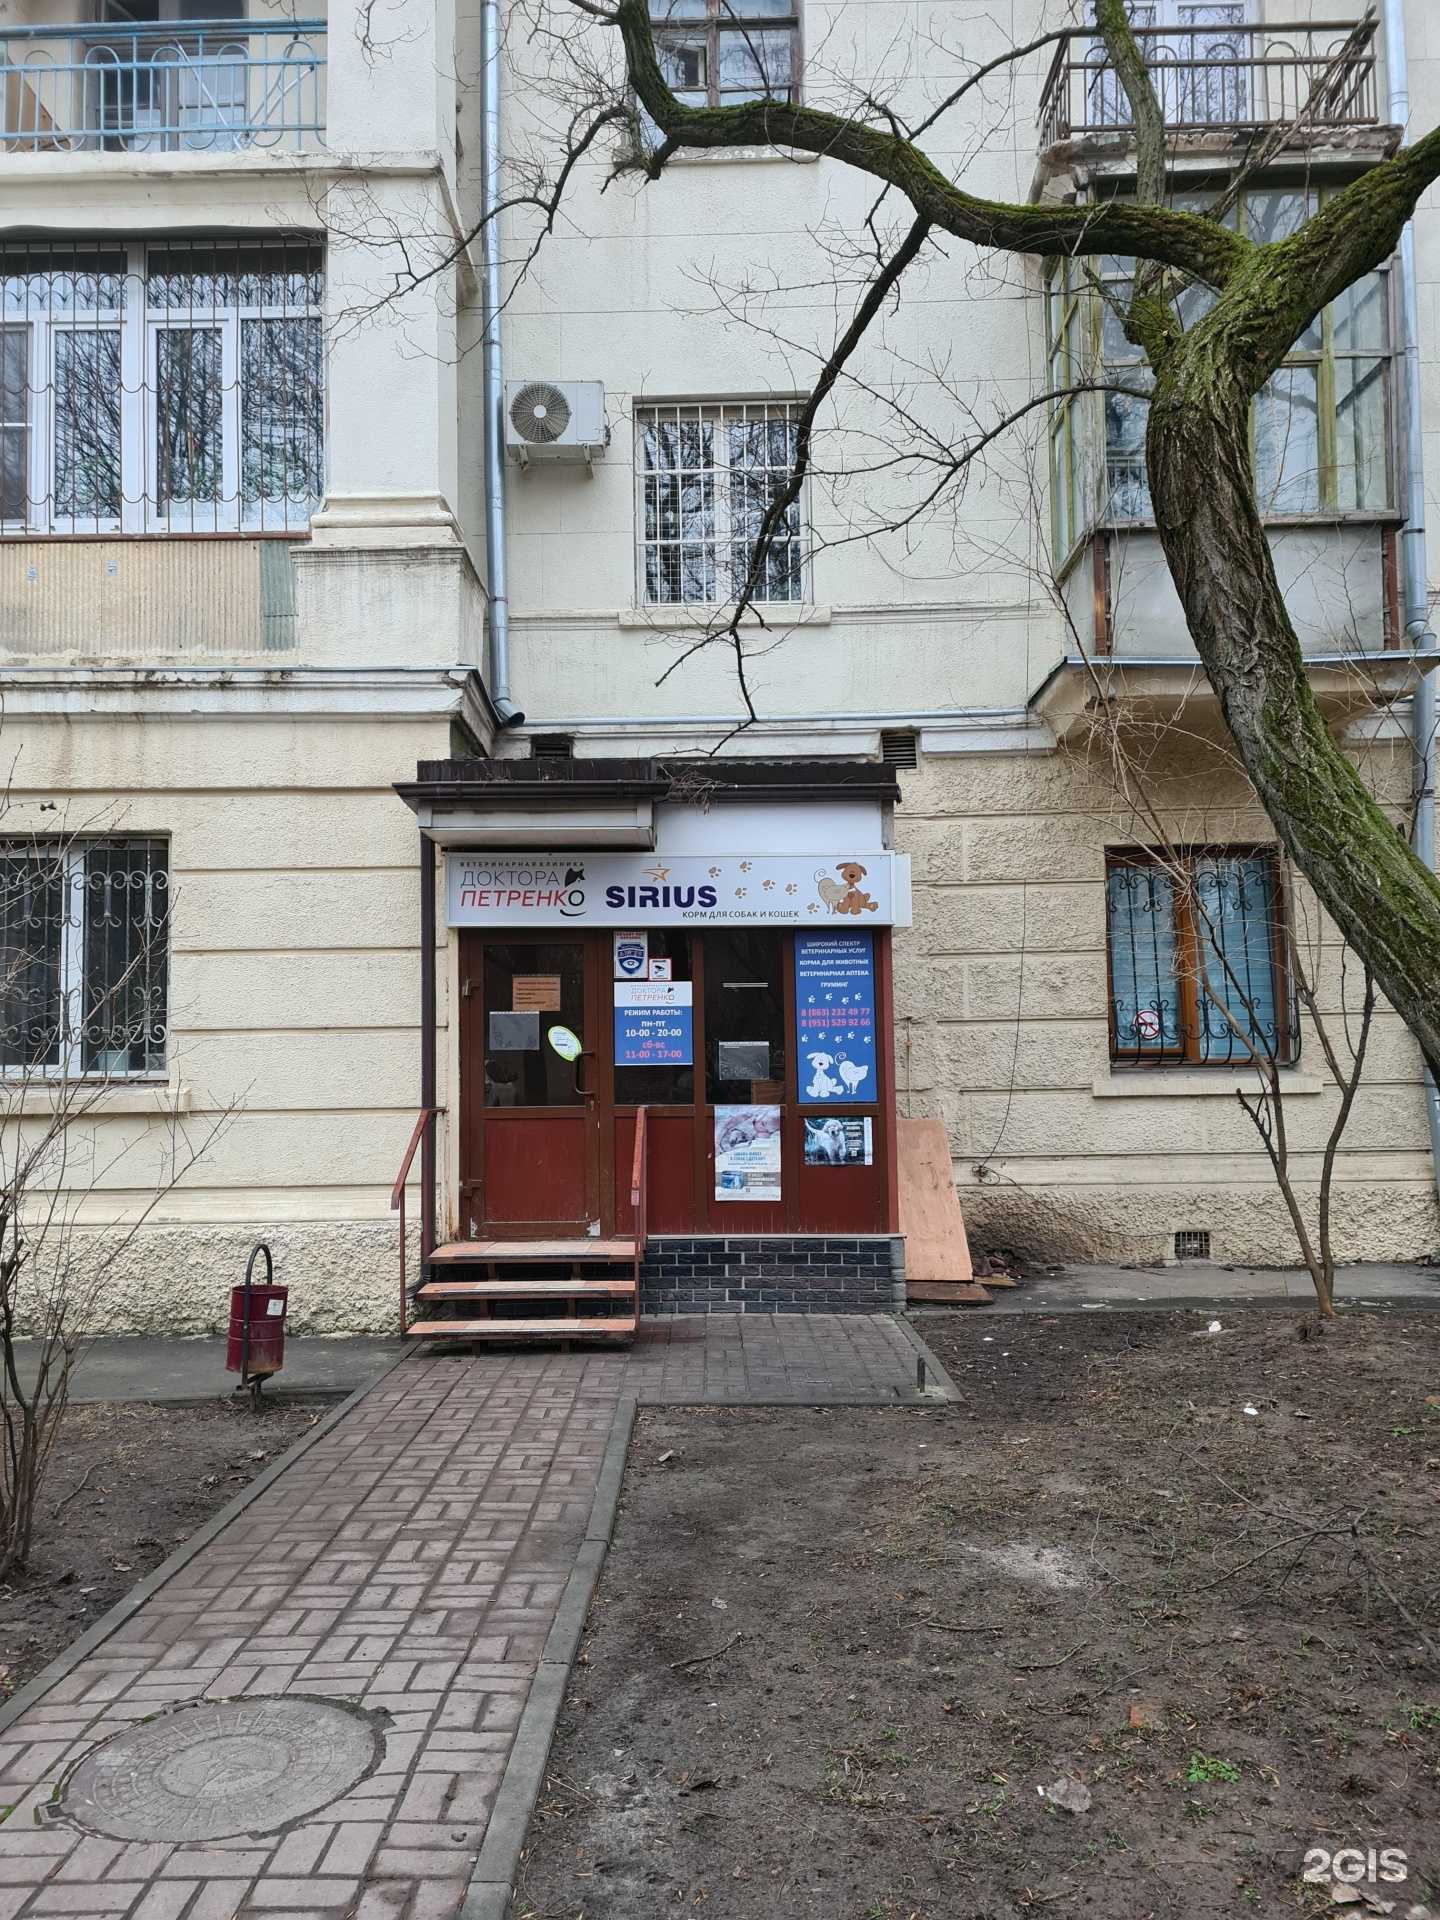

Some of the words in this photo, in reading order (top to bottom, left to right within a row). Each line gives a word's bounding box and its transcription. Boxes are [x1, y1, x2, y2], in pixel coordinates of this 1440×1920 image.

[460, 870, 560, 889] ДОКТОРА
[460, 889, 585, 907] ПЕТРЕНКО
[605, 885, 718, 908] SIRIUS
[708, 911, 728, 919] ДЛЯ
[729, 910, 758, 918] СОБАК
[760, 910, 767, 918] И
[768, 910, 800, 918] КОШЕК
[625, 1029, 650, 1037] 10-00
[657, 1028, 682, 1037] 20-00
[625, 1050, 650, 1058] 11-00
[657, 1050, 682, 1058] 17-00
